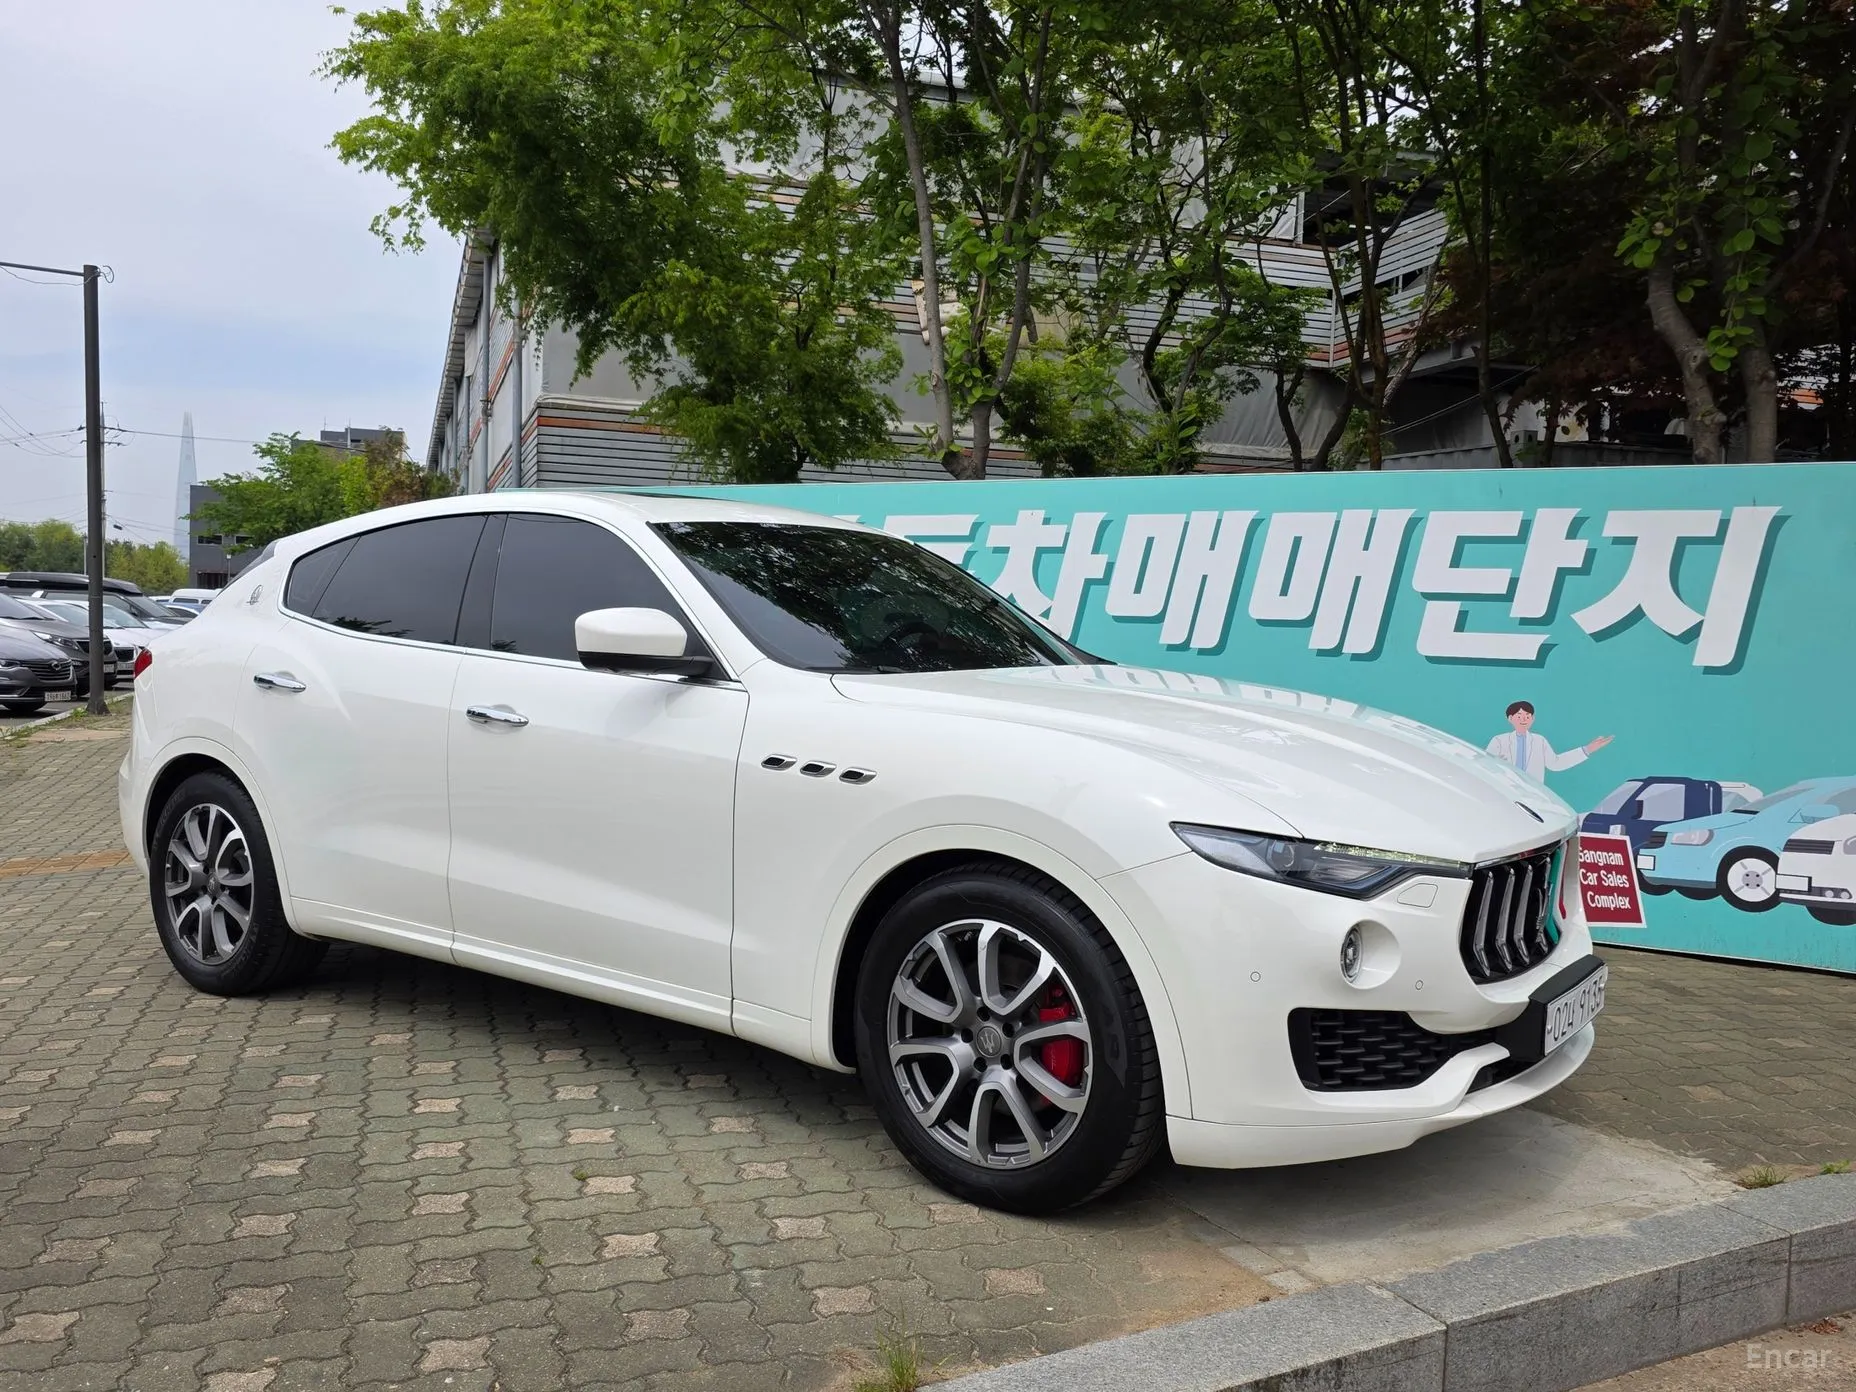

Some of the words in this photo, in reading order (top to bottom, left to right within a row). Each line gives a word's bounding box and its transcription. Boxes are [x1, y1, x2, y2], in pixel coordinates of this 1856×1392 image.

[831, 505, 1785, 668] 차매매단지
[1580, 868, 1598, 885] Car
[1600, 870, 1630, 888] Sales
[1587, 891, 1631, 911] Complex
